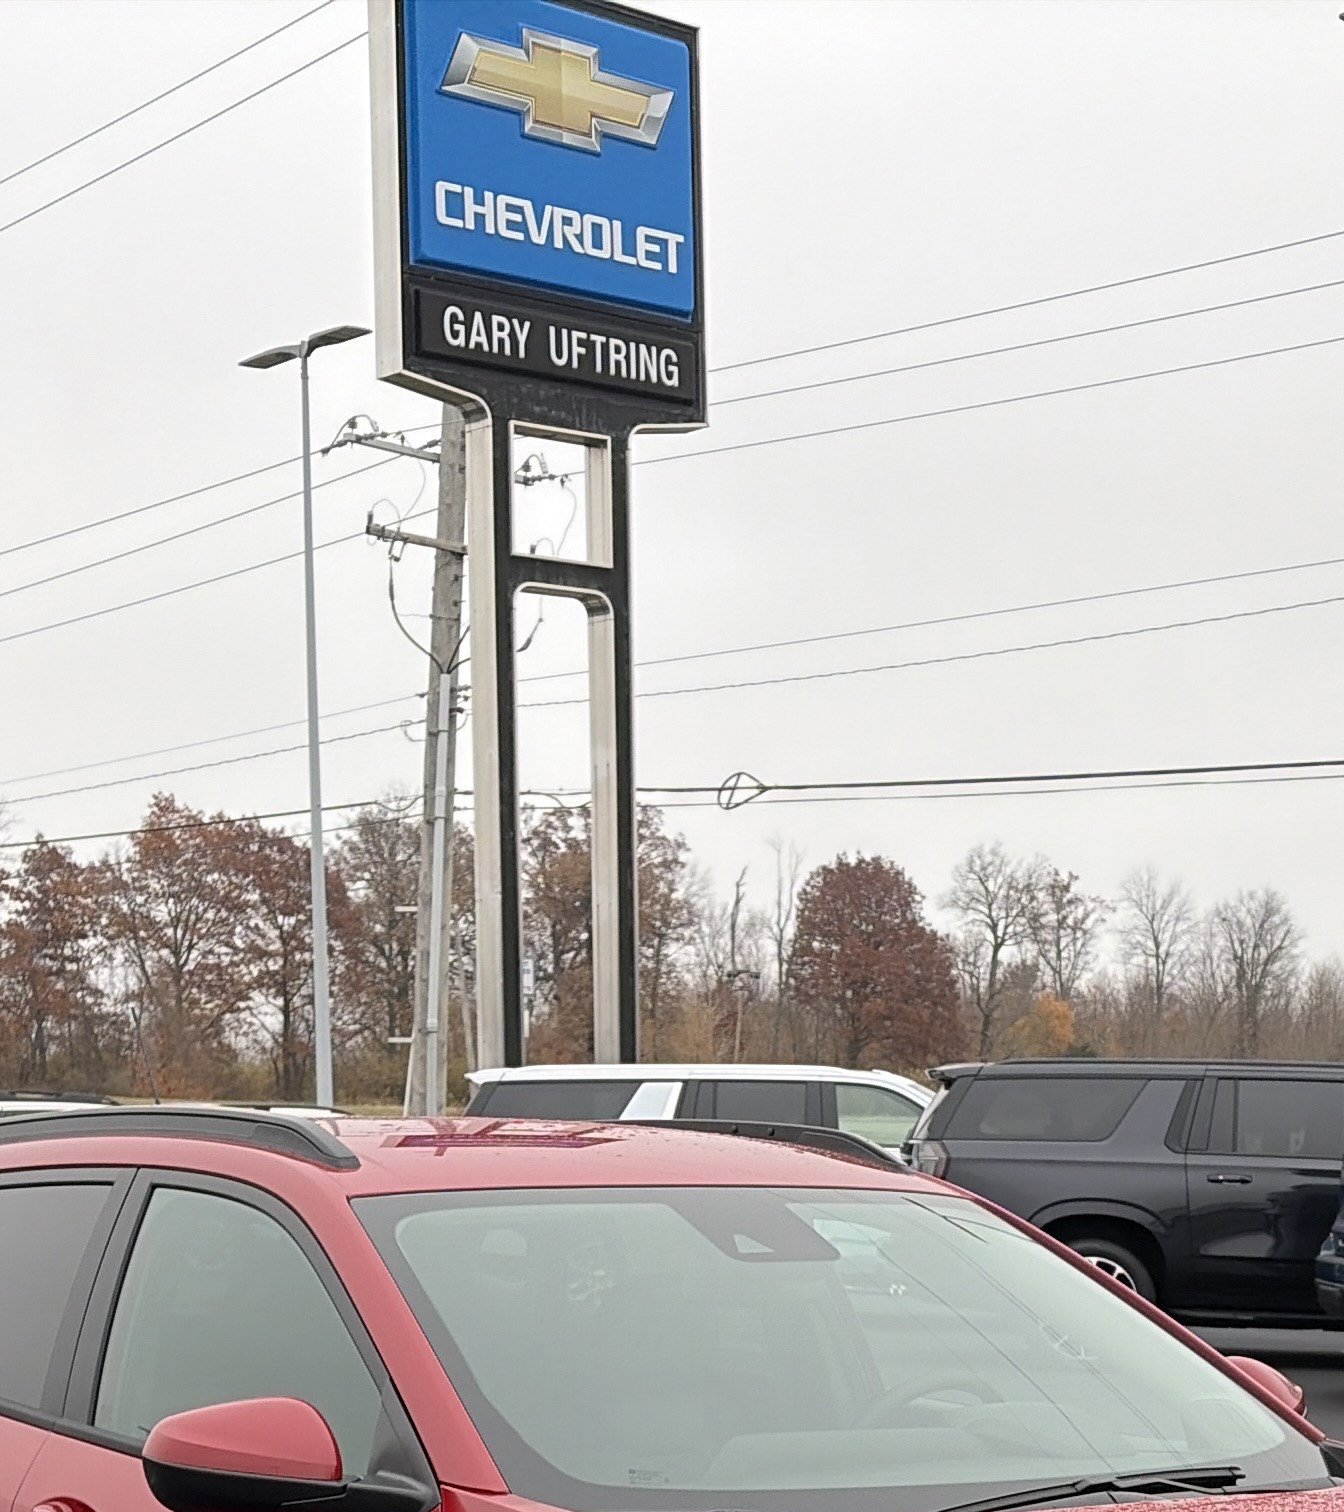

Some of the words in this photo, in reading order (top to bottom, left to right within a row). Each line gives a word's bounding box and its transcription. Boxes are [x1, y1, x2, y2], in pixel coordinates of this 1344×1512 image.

[434, 180, 685, 274] CHEVROLET
[442, 305, 531, 360] GARY
[549, 325, 680, 388] UFTRING
